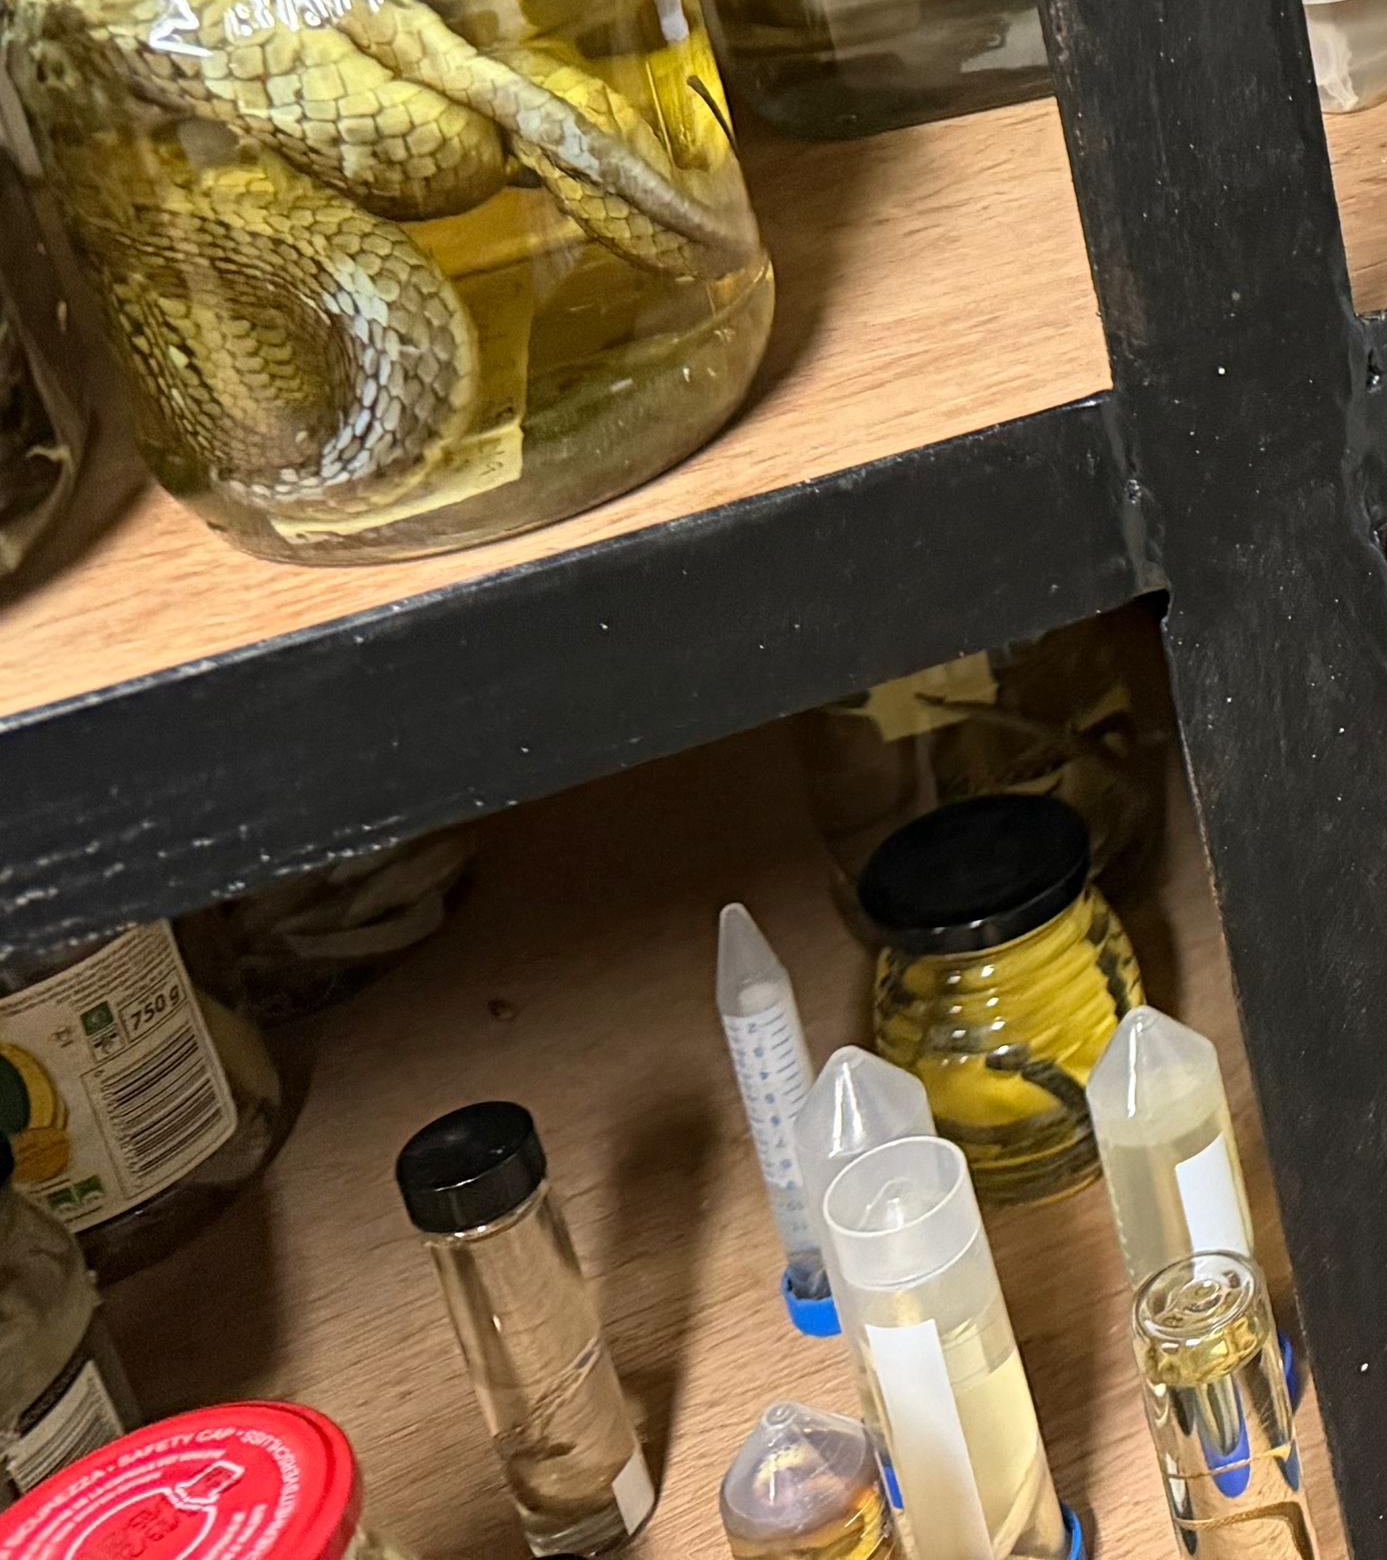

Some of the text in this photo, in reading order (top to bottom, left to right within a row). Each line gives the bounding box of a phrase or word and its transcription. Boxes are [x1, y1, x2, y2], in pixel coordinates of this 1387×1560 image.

[130, 992, 166, 1032] 750
[117, 1433, 195, 1468] SAFETY
[196, 1427, 236, 1443] CAP
